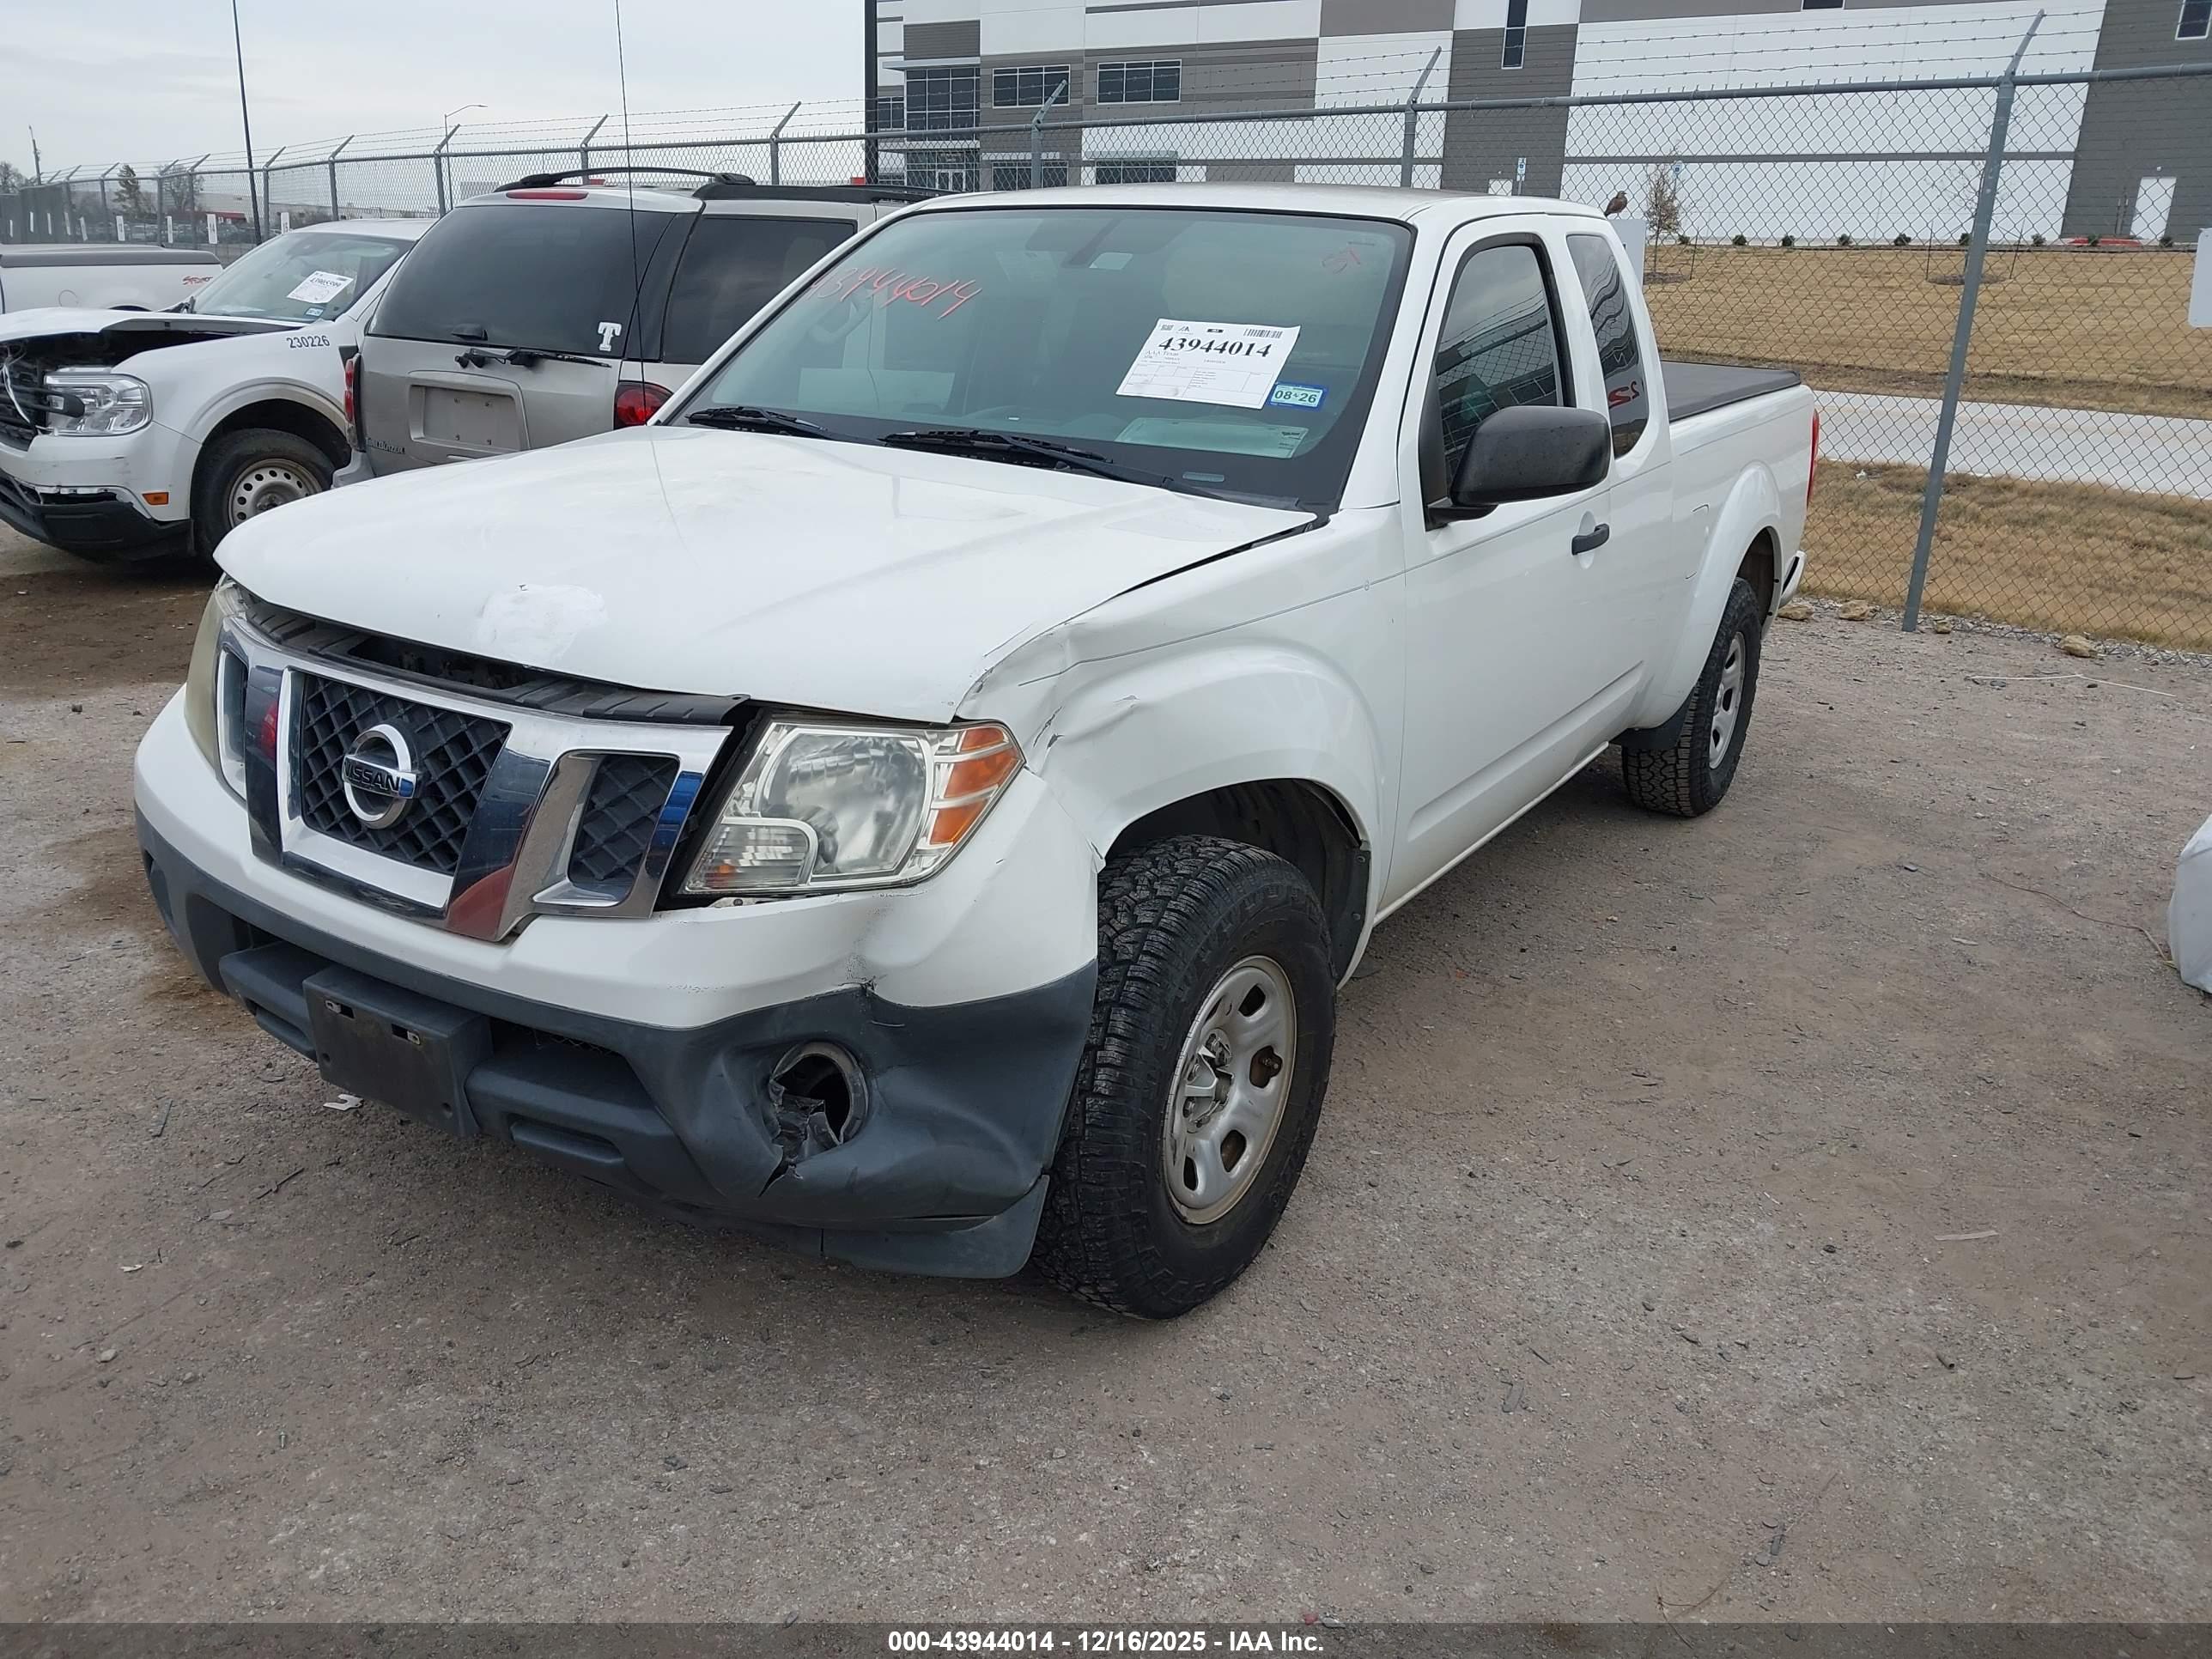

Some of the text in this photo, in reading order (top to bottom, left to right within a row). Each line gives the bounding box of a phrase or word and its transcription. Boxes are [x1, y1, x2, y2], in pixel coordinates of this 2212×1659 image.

[286, 335, 331, 349] 230226
[598, 321, 623, 352] T
[1158, 337, 1273, 357] 43944014
[344, 760, 400, 792] NISSAN
